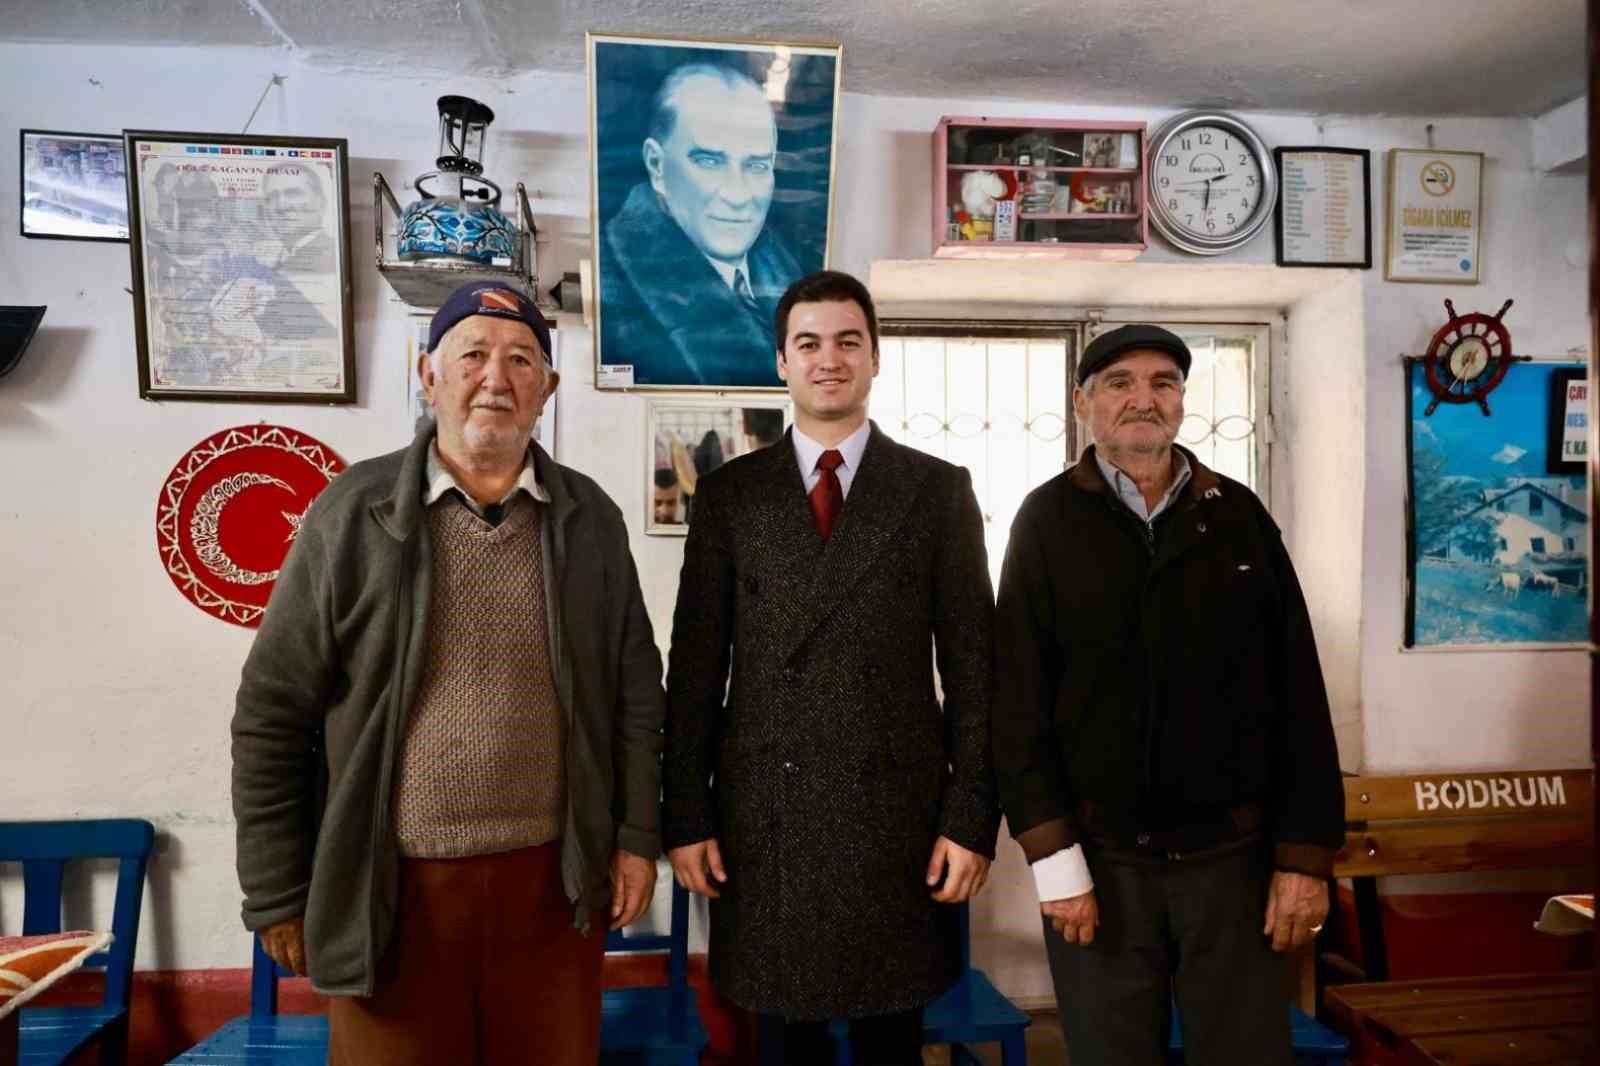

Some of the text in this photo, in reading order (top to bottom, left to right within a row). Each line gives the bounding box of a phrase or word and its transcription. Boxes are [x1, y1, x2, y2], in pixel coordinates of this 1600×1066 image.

[1181, 138, 1191, 151] 11
[1198, 133, 1212, 145] 12
[1224, 138, 1229, 151] 1
[1166, 155, 1178, 167] 10
[1239, 153, 1247, 166] 2
[1160, 176, 1170, 188] 9
[1246, 175, 1255, 187] 3
[1169, 198, 1178, 210] 8
[1241, 197, 1248, 209] 4
[1185, 214, 1193, 226] 7
[1206, 218, 1215, 230] 6
[1226, 213, 1235, 225] 5
[1414, 776, 1567, 811] BODRUM
